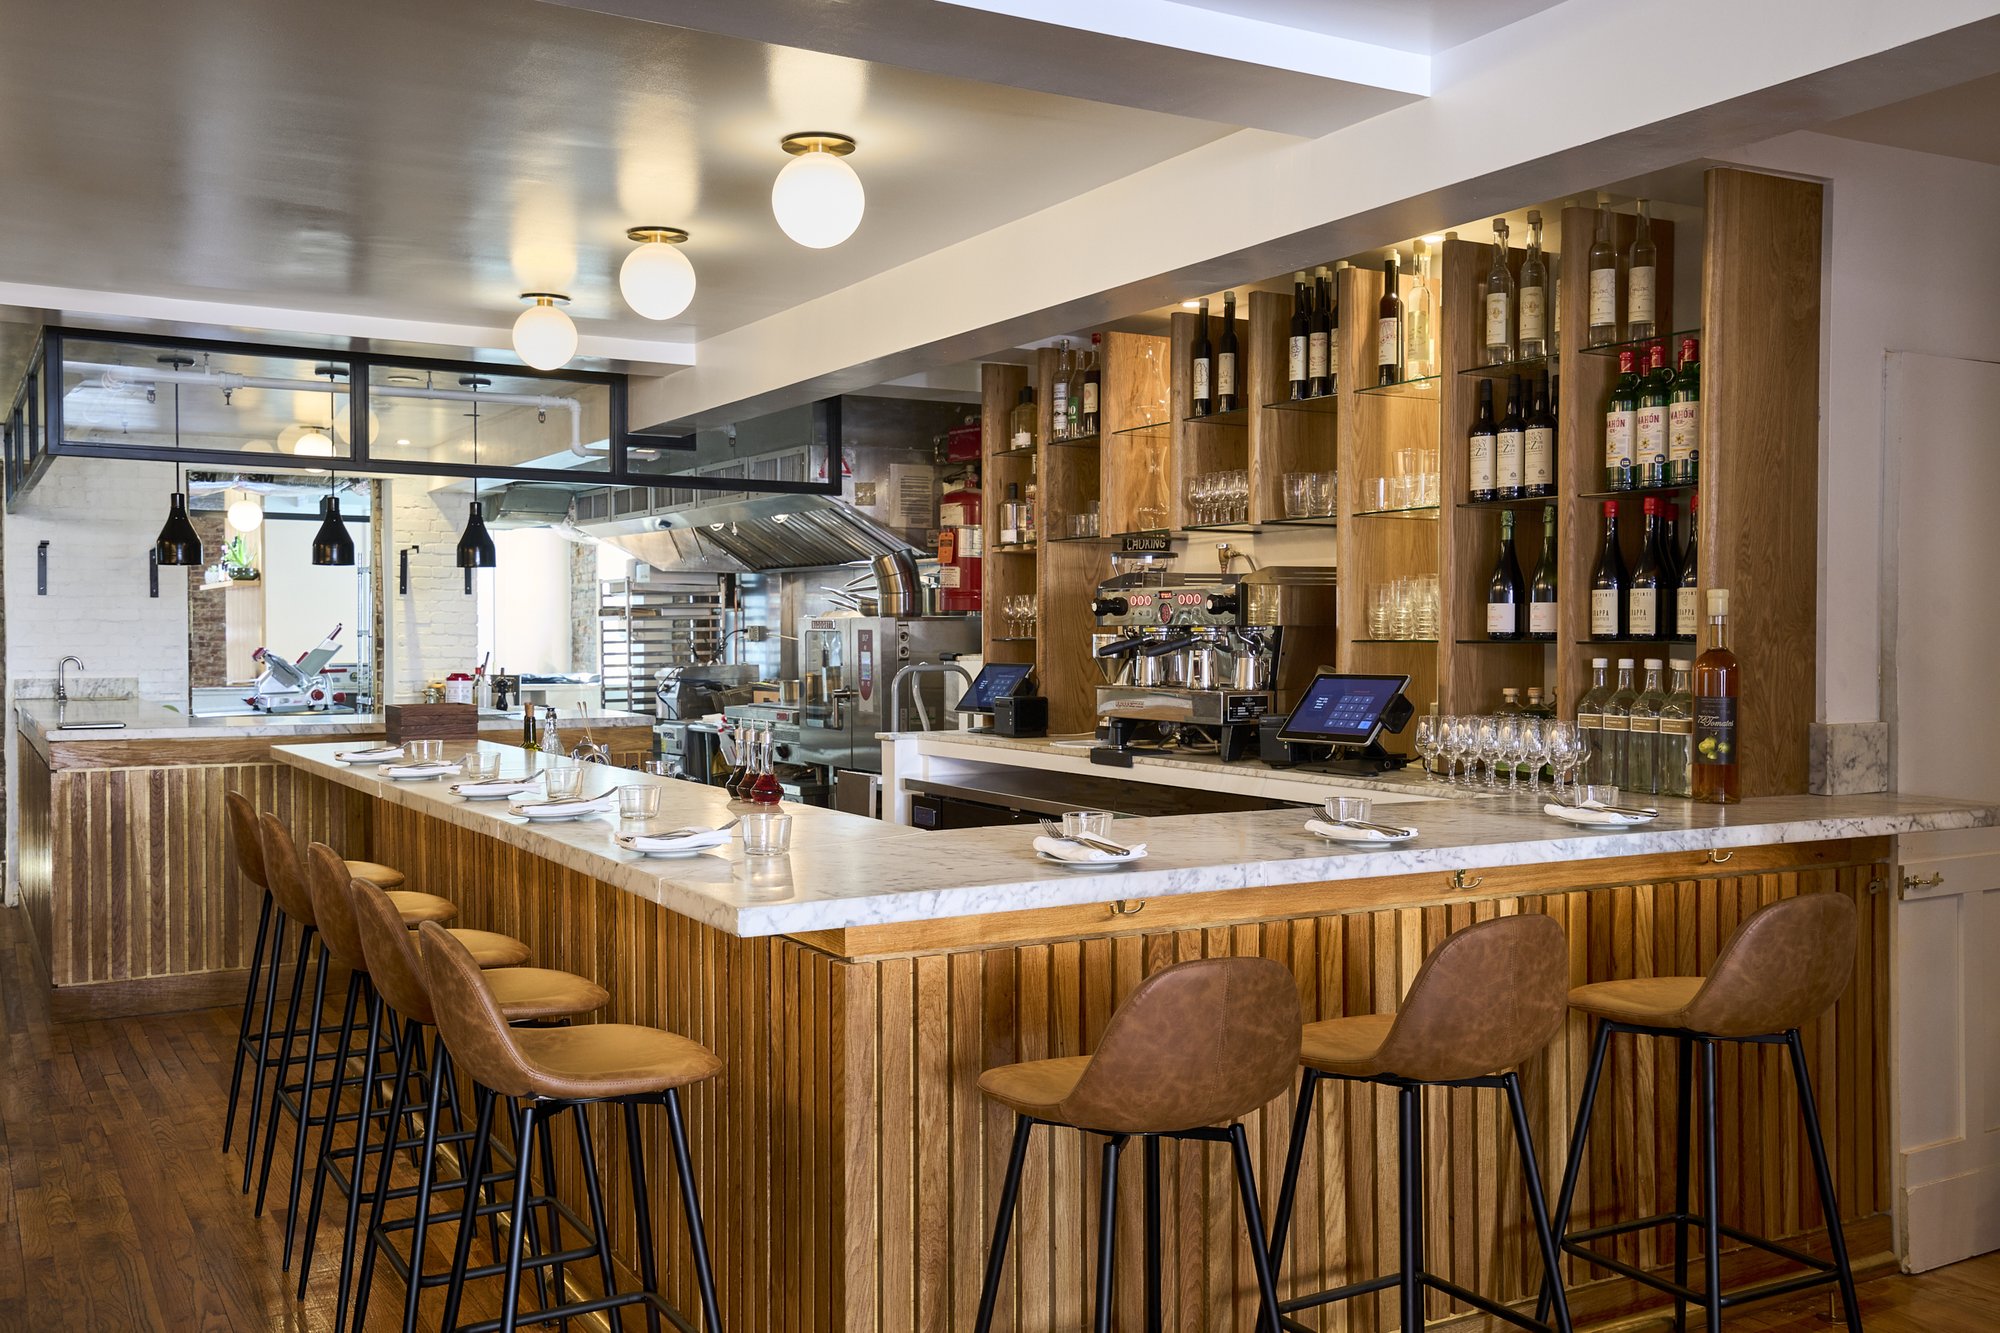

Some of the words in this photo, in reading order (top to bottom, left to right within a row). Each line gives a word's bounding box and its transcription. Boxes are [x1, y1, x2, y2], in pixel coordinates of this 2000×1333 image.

[1608, 417, 1626, 429] AHÓN
[191, 472, 217, 483] 3M
[247, 474, 275, 484] 3M
